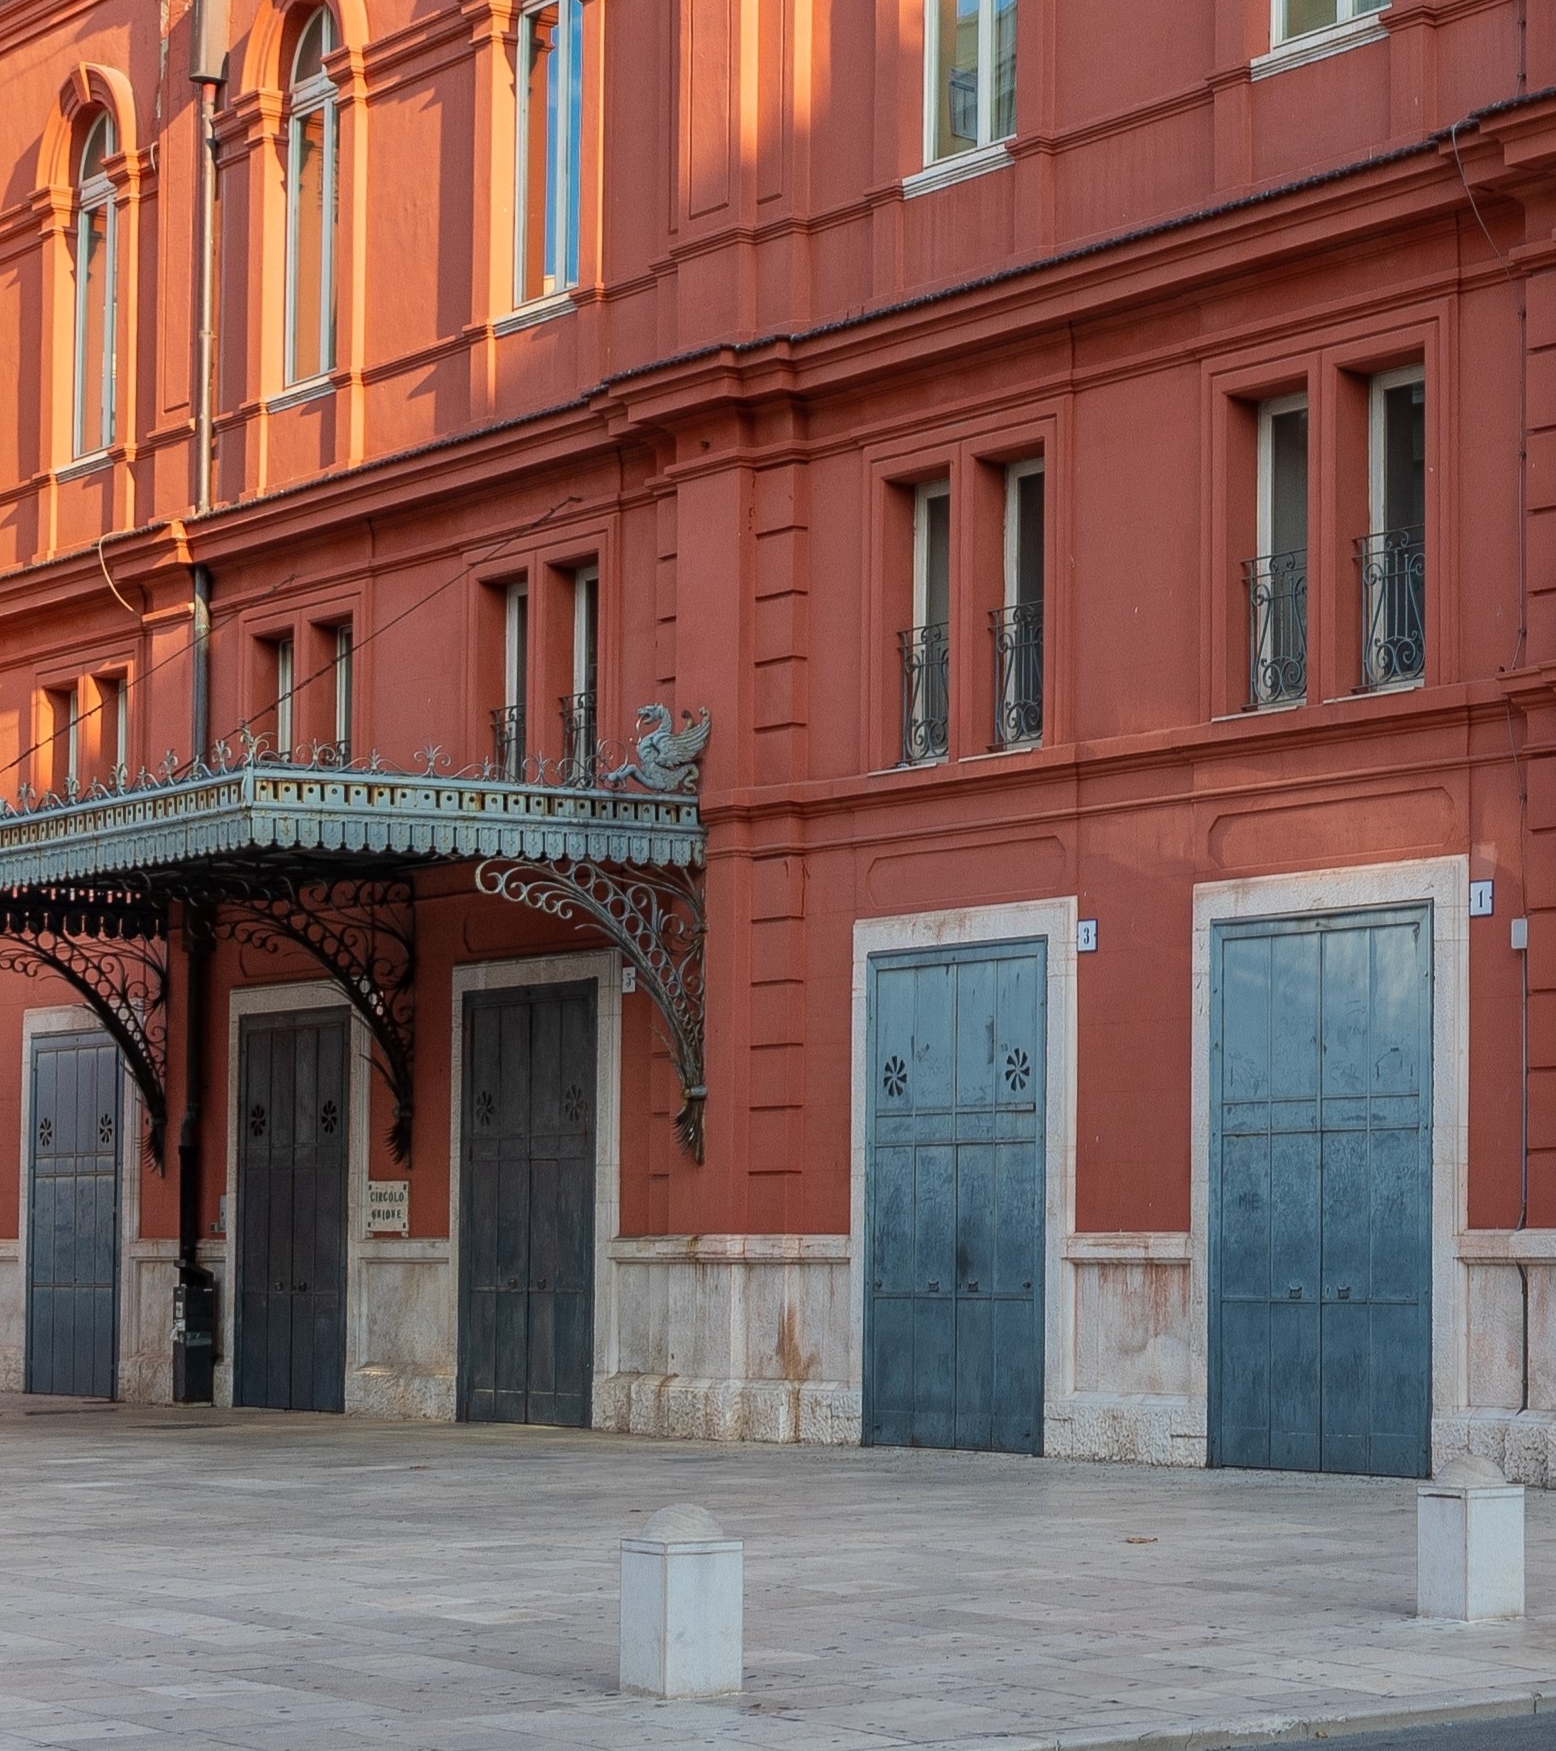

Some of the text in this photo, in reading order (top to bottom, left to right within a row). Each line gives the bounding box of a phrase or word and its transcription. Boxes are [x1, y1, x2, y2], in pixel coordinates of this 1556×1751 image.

[1479, 889, 1483, 908] 1
[1084, 927, 1090, 944] 3
[370, 1191, 404, 1202] CIRCOLO
